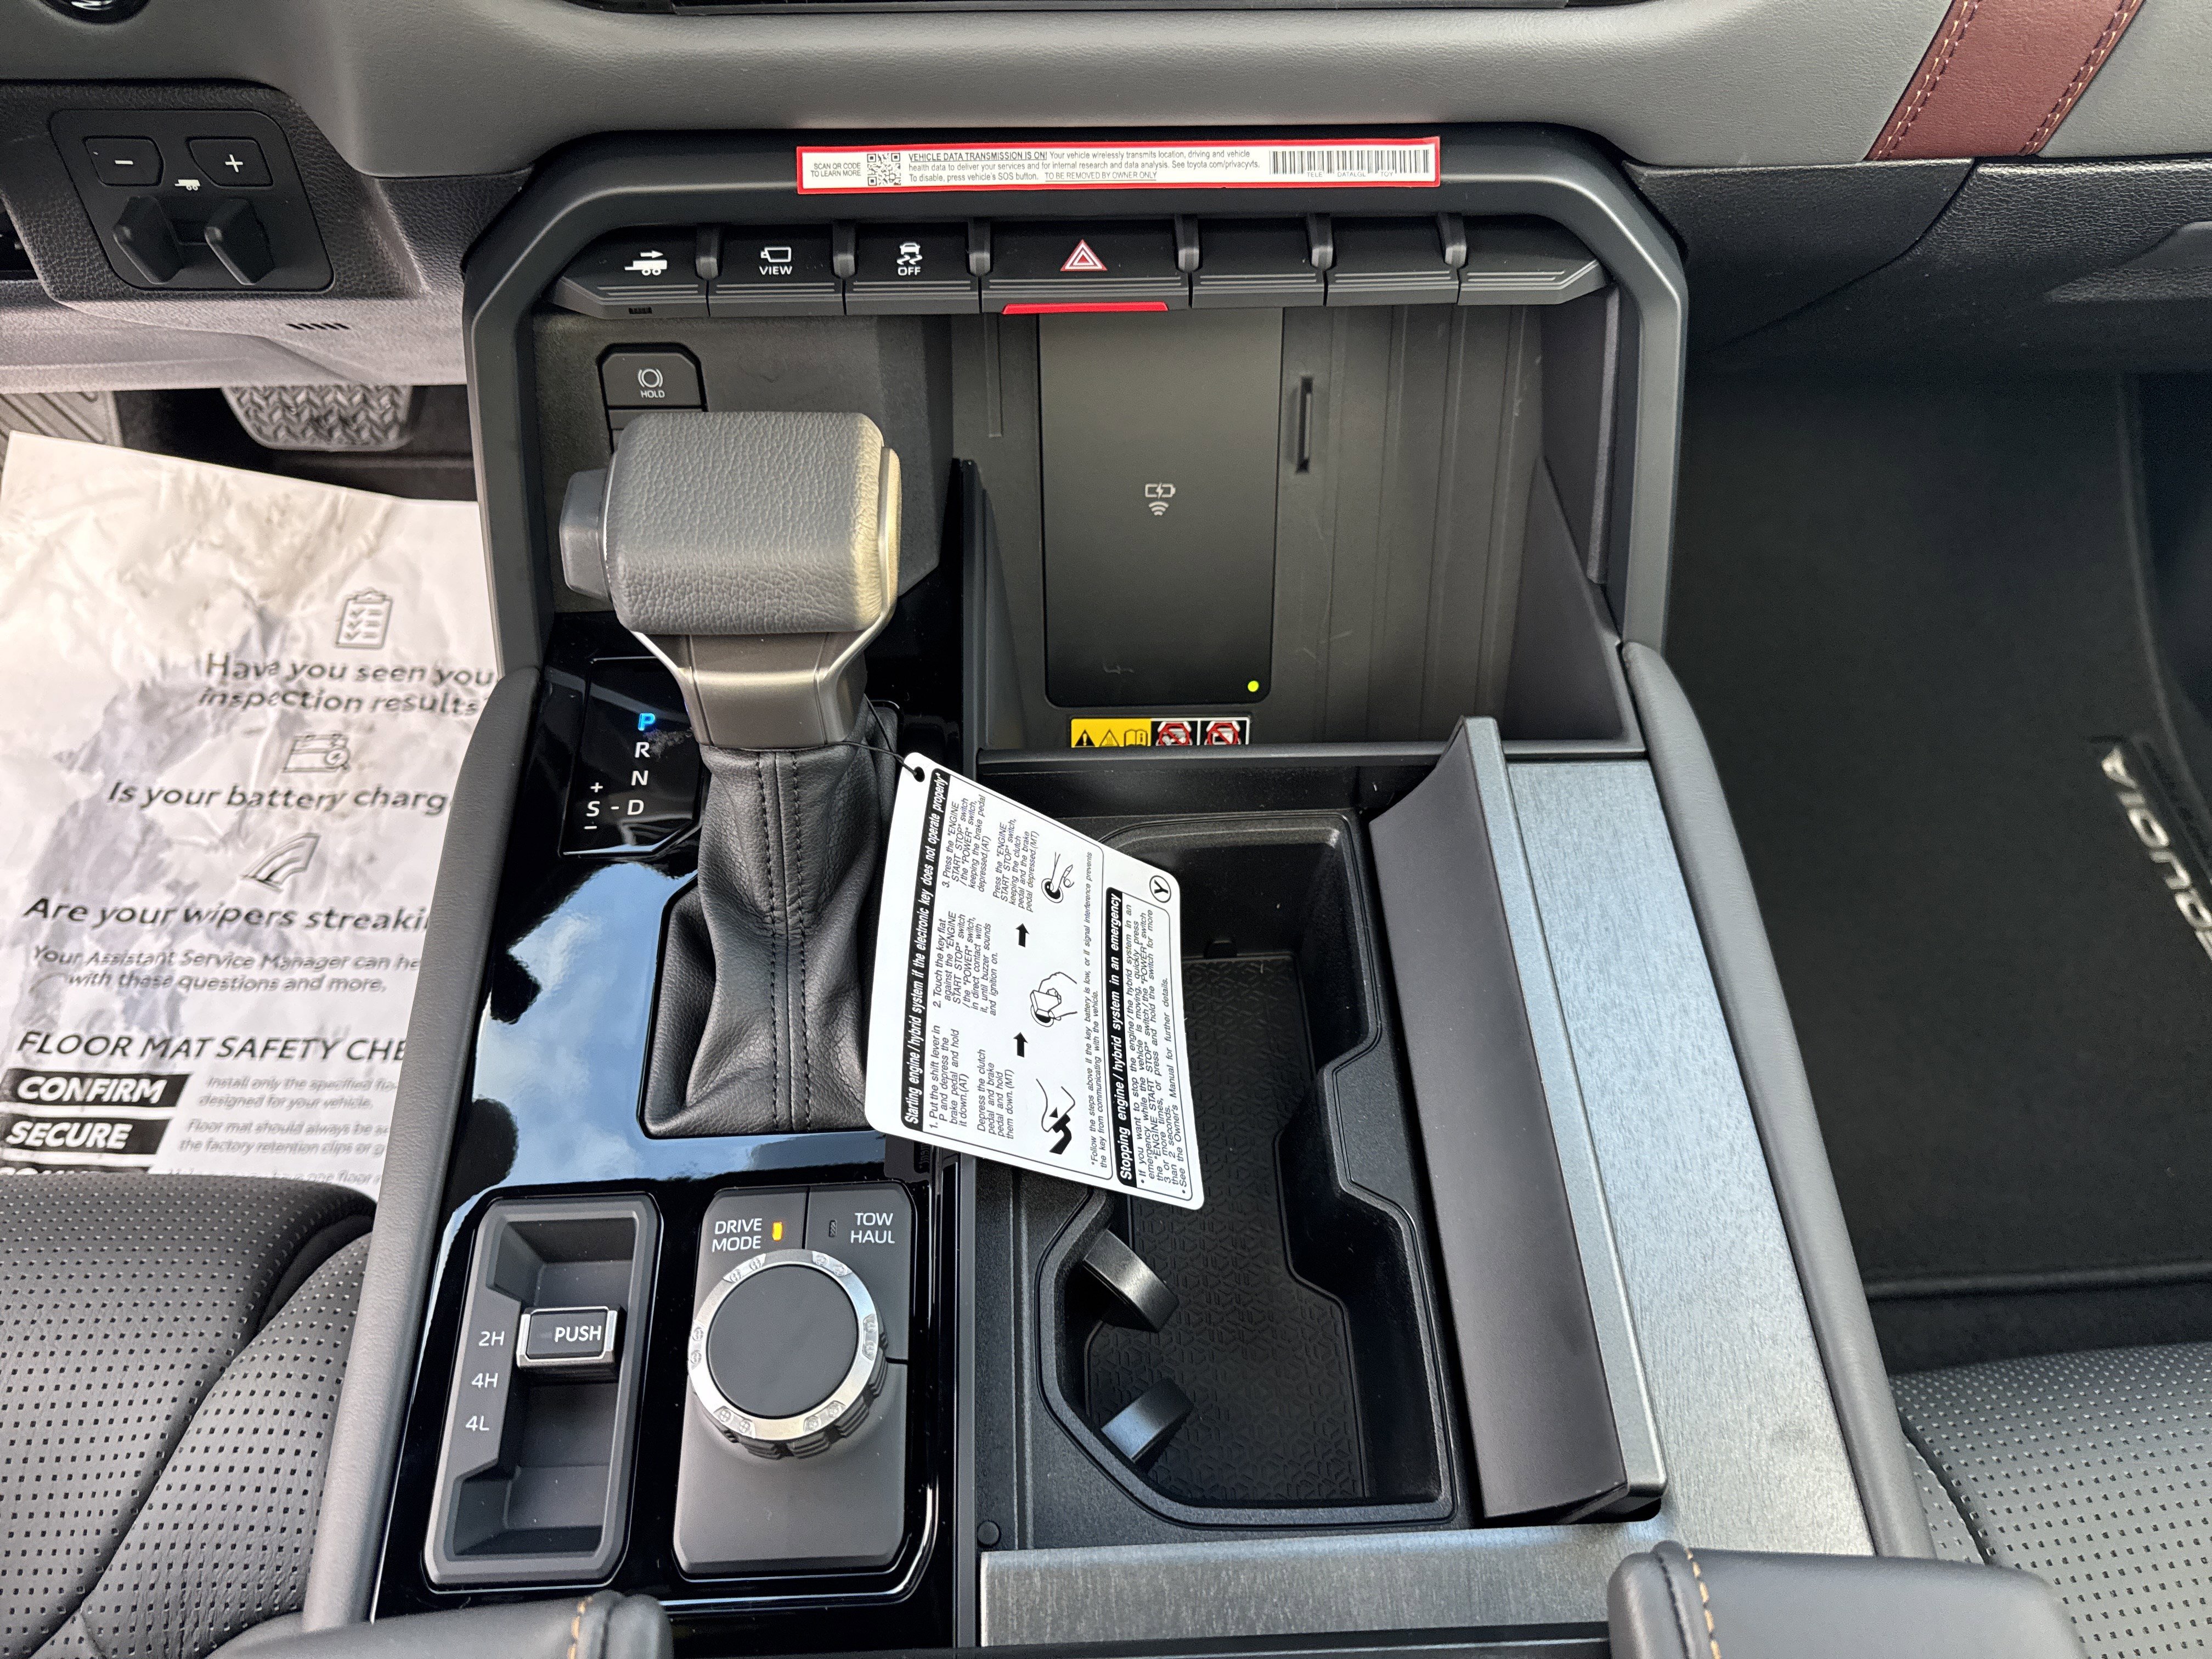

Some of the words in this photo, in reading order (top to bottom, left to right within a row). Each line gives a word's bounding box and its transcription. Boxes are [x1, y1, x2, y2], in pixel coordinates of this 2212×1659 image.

[908, 153, 941, 161] VEHICLE
[943, 152, 964, 161] DATA
[964, 151, 1023, 160] TRANSMISSION
[1025, 151, 1032, 160] IS
[1048, 151, 1065, 159] Your
[1066, 151, 1090, 159] vehicle
[1092, 151, 1125, 160] wirelessly
[1158, 150, 1186, 160] location,
[1188, 150, 1210, 159] driving
[1212, 150, 1224, 158] and
[1227, 149, 1250, 157] vehicle
[909, 163, 929, 172] health
[931, 163, 946, 171] data
[948, 163, 955, 171] to
[980, 163, 996, 173] your
[1027, 161, 1040, 170] and
[1041, 161, 1051, 170] for
[1052, 161, 1077, 170] internal
[1079, 161, 1108, 170] research
[1110, 161, 1122, 169] and
[1124, 161, 1139, 169] data
[1172, 160, 1185, 168] See
[909, 173, 917, 182] To
[919, 173, 945, 182] disable,
[947, 174, 966, 183] press
[967, 172, 996, 181] vehicle's
[998, 172, 1014, 180] SOS
[1015, 172, 1039, 180] button.
[1044, 172, 1054, 180] TO
[1056, 172, 1064, 180] BE
[1066, 171, 1101, 179] REMOVED
[1102, 171, 1111, 179] BY
[1112, 171, 1138, 179] OWNER
[1139, 171, 1158, 179] ONLY
[758, 265, 793, 276] VIEW
[897, 266, 921, 276] OFF
[640, 390, 665, 398] HOLD
[206, 652, 279, 680] Have
[284, 659, 346, 684] you
[354, 664, 425, 684] seen
[433, 669, 497, 687] you
[199, 687, 364, 712] inspection
[372, 691, 488, 714] results
[638, 713, 655, 731] P
[634, 742, 650, 758] R
[631, 770, 648, 786] N
[108, 781, 137, 802] Is
[141, 788, 221, 810] your
[227, 783, 348, 814] battery
[354, 784, 451, 816] charg
[627, 799, 644, 815] D
[928, 813, 940, 844] operate
[924, 845, 936, 862] not
[920, 864, 934, 886] does
[1153, 878, 1168, 894] Y
[917, 888, 933, 906] key
[23, 898, 88, 923] Are
[90, 905, 177, 930] your
[183, 901, 295, 932] wipers
[1110, 893, 1121, 951] emergency
[913, 907, 929, 951] electronic
[32, 945, 82, 964] Your
[87, 950, 176, 966] Assistant
[179, 950, 254, 969] Service
[259, 953, 349, 972] Manager
[353, 957, 390, 970] can
[912, 953, 926, 968] the
[1111, 956, 1119, 970] an
[68, 973, 112, 987] with
[118, 973, 173, 988] these
[179, 975, 278, 993] questions
[283, 976, 322, 991] and
[911, 969, 924, 979] if
[1109, 974, 1120, 986] in
[910, 980, 925, 1014] system
[1161, 978, 1169, 1007] details.
[1110, 991, 1124, 1031] system
[931, 1025, 940, 1035] in
[1163, 1012, 1172, 1042] further
[16, 1031, 132, 1058] FLOOR
[140, 1036, 216, 1060] MAT
[217, 1036, 347, 1062] SAFETY
[347, 1038, 405, 1062] CHE
[930, 1035, 940, 1059] lever
[940, 1037, 949, 1051] the
[950, 1028, 960, 1048] hold
[950, 1050, 959, 1068] and
[930, 1060, 939, 1082] shift
[939, 1054, 950, 1090] depress
[949, 1071, 960, 1096] pedal
[1166, 1064, 1177, 1098] Manual
[17, 1076, 168, 1105] CONFIRM
[929, 1084, 939, 1100] the
[905, 1086, 921, 1124] Starting
[929, 1102, 938, 1119] Put
[939, 1092, 948, 1111] and
[939, 1113, 948, 1122] P
[949, 1100, 958, 1125] brake
[1171, 1104, 1182, 1142] Owner's
[6, 1120, 133, 1151] SECURE
[1117, 1126, 1133, 1180] Stopping
[1176, 1147, 1184, 1162] the
[1179, 1167, 1187, 1188] See
[714, 1218, 763, 1235] DRIVE
[854, 1212, 893, 1226] TOW
[712, 1234, 761, 1252] MODE
[850, 1229, 895, 1245] HAUL
[478, 1331, 505, 1347] 2H
[554, 1326, 602, 1342] PUSH
[472, 1373, 498, 1389] 4H
[465, 1417, 489, 1431] 4L
